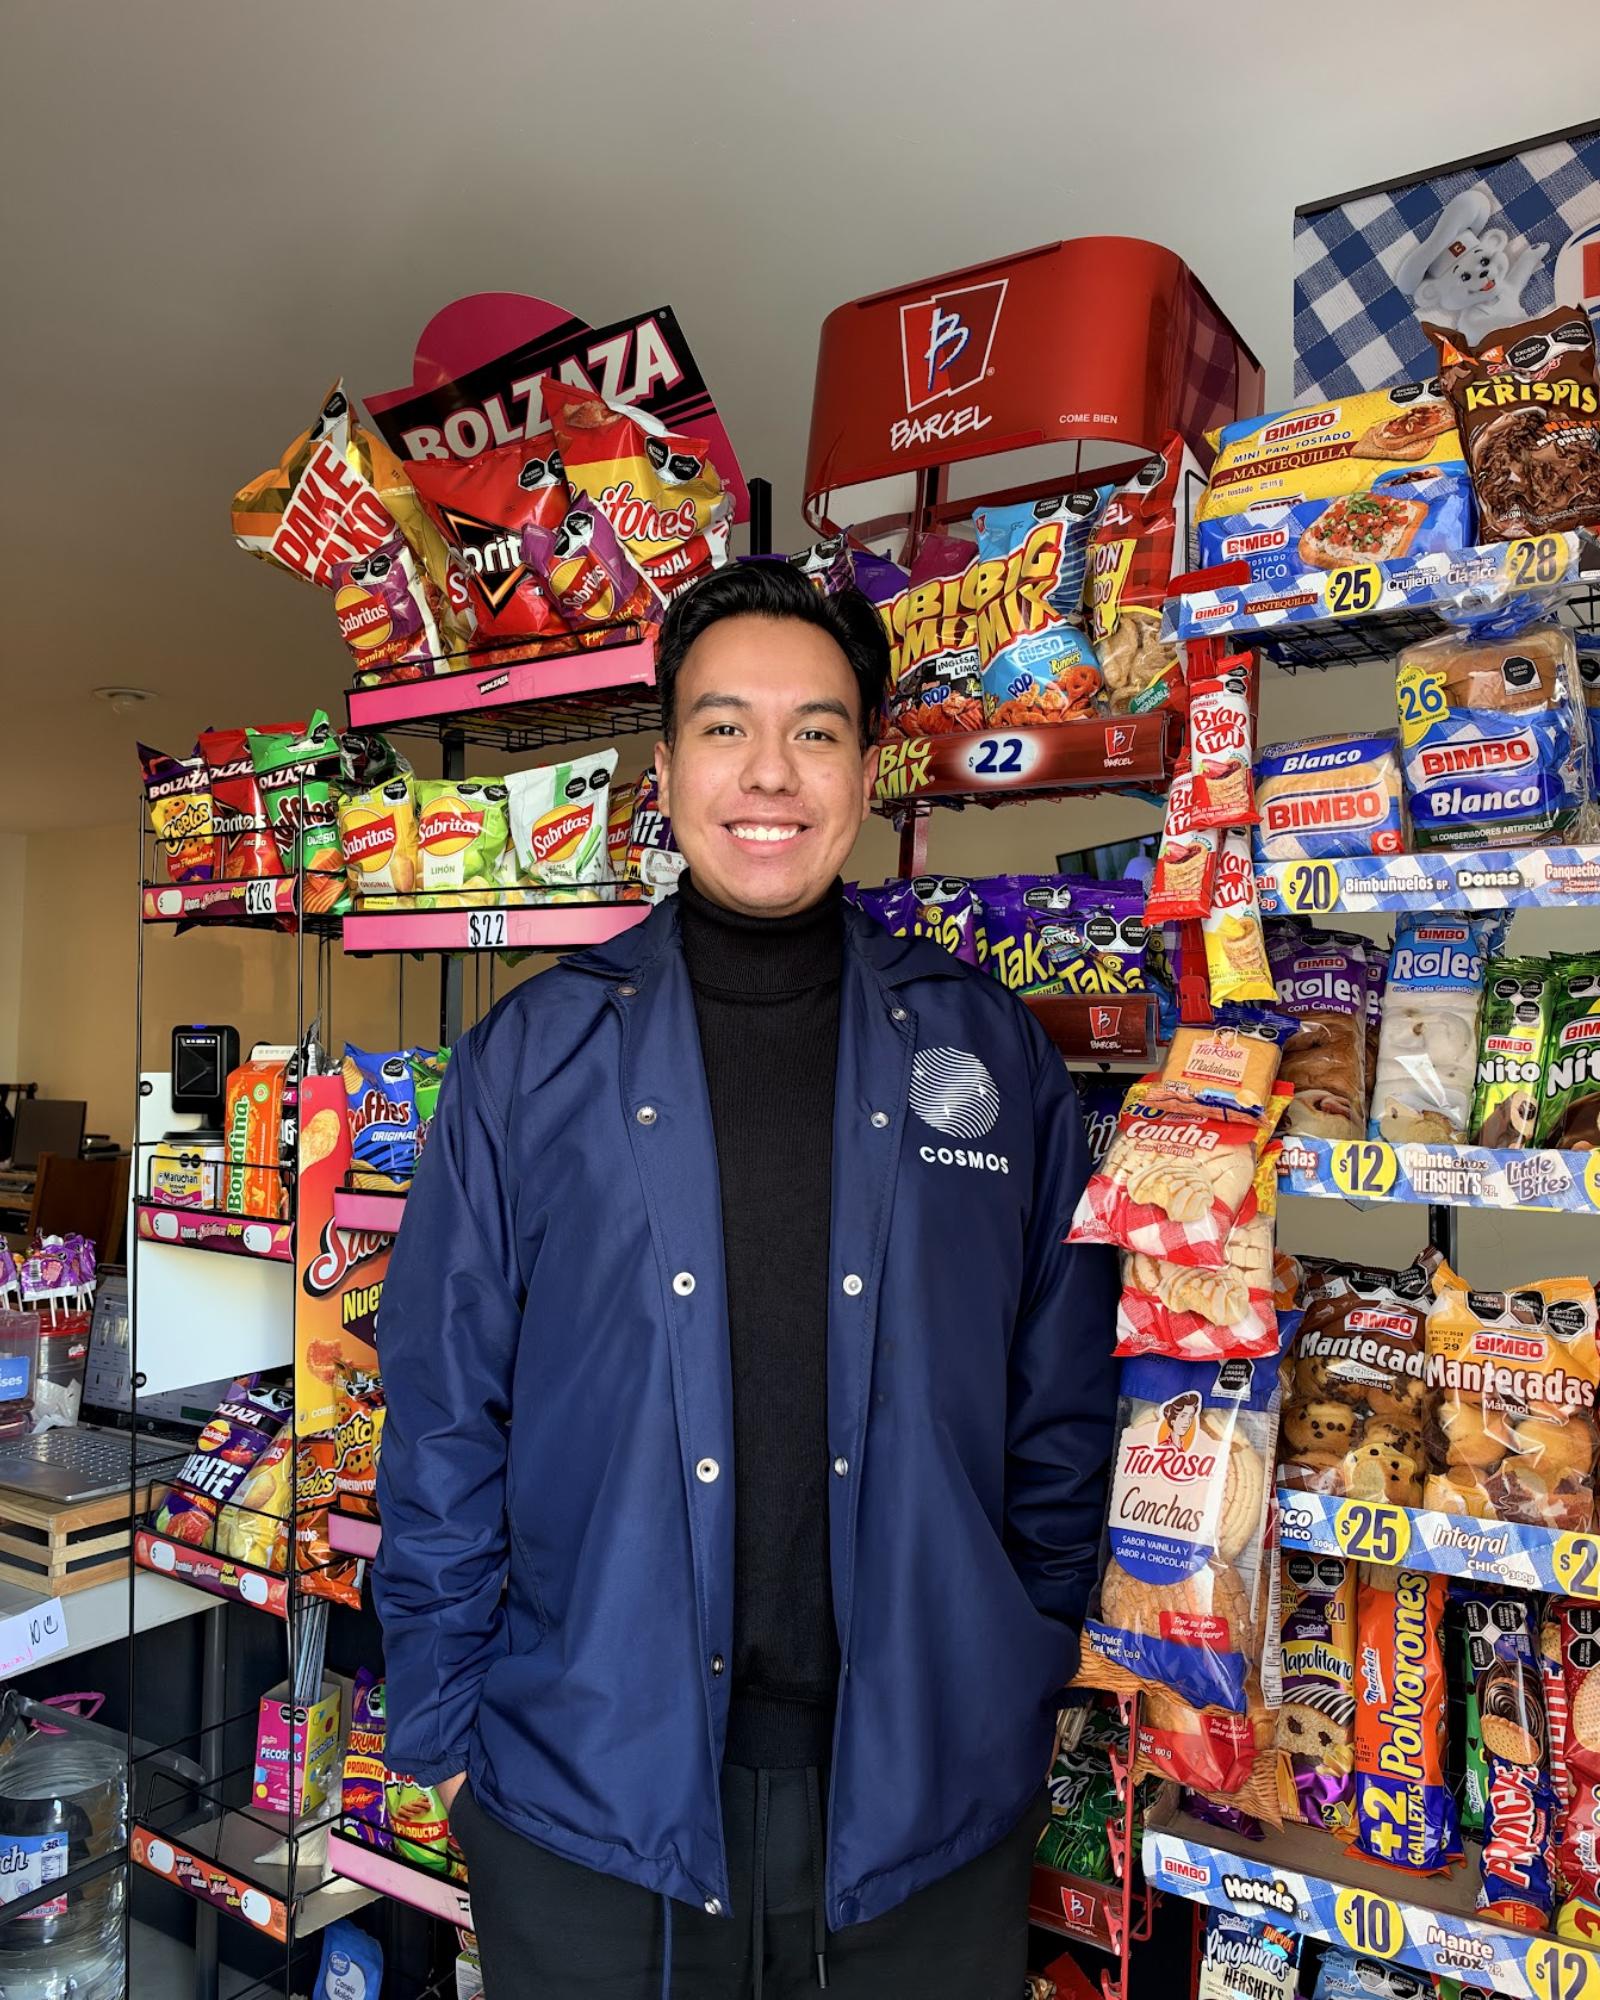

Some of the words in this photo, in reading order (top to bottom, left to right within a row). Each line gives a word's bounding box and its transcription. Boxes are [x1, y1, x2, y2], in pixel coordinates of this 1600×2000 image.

[1466, 380, 1599, 412] KRISPIS
[891, 405, 992, 450] BARCEL
[1059, 413, 1089, 424] COME
[1093, 413, 1118, 424] BIEN
[1263, 410, 1336, 443] BIMBO
[1233, 451, 1261, 464] MINI
[1266, 445, 1290, 457] PAN
[1296, 431, 1351, 451] TOSTADO
[1232, 446, 1350, 482] MANTEQUILLA
[1227, 483, 1254, 498] tostado
[1226, 530, 1286, 555] BIMBO
[977, 524, 1060, 613] BIG
[1251, 554, 1287, 568] OSTADO
[1251, 563, 1288, 581] SICO
[1447, 566, 1498, 585] Clásico
[1510, 538, 1558, 586] $28
[563, 565, 607, 611] Sabritas
[1329, 568, 1372, 613] $25
[1386, 573, 1441, 592] Crujiente
[1195, 602, 1235, 621] BIMBO
[1247, 596, 1315, 613] MANTEQUILLA
[338, 602, 389, 639] Sabritas
[977, 577, 1061, 672] MIX
[1017, 638, 1061, 664] QUESO
[922, 685, 950, 708] POP
[1008, 673, 1033, 698] POP
[1194, 706, 1248, 731] Bran
[1200, 725, 1245, 753] Frut
[879, 736, 931, 777] BIG
[968, 738, 1023, 774] $22
[1282, 749, 1361, 773] Blanco
[1422, 739, 1531, 776] BIMBO
[149, 769, 209, 799] BOLZAZA
[875, 755, 933, 800] MIX
[1267, 791, 1380, 831] BIMBO
[1431, 786, 1540, 818] Blanco
[164, 802, 210, 856] Cheetos
[418, 814, 480, 843] Sabritas
[533, 812, 591, 857] Sabritas
[1377, 832, 1397, 851] G
[1503, 820, 1554, 834] ARTIFICIALES
[342, 826, 395, 859] Sabritas
[430, 864, 455, 876] LIMÓN
[1345, 874, 1434, 893] Bimbuñuelos
[1459, 871, 1519, 887] Donas
[1546, 862, 1600, 879] Panquecito
[360, 882, 391, 890] ORIGINAL
[1289, 865, 1331, 911] $20
[469, 912, 504, 948] $22
[1418, 928, 1466, 941] BIMBO
[1299, 957, 1344, 969] BIMBO
[1393, 949, 1482, 981] Roles
[1276, 971, 1361, 1006] Roles
[1287, 1003, 1308, 1014] con
[1311, 999, 1353, 1015] Canela
[1488, 1038, 1533, 1053] BIMBO
[1477, 1059, 1540, 1084] Nito
[370, 1130, 416, 1142] ORIGINAL
[1126, 1120, 1220, 1150] Concha
[227, 1100, 248, 1212] Bonafina
[919, 1145, 1010, 1175] COSMOS
[1339, 1144, 1384, 1193] $12
[1505, 1154, 1554, 1185] Little
[163, 1172, 198, 1185] Maruchan
[1413, 1168, 1482, 1196] HERSHEY'S
[1519, 1170, 1571, 1200] Bites
[1349, 1310, 1413, 1333] BIMBO
[1474, 1334, 1544, 1358] BIMBO
[1348, 1375, 1393, 1391] Chocolate
[1427, 1353, 1595, 1408] Mantecadas
[1485, 1399, 1529, 1415] Mármol
[1120, 1486, 1205, 1533] Conchas
[1121, 1534, 1147, 1548] SABOR
[1147, 1539, 1182, 1554] VAINILLA
[1182, 1547, 1189, 1556] Y
[1341, 1506, 1398, 1561] $25
[1433, 1524, 1508, 1557] Integral
[1115, 1546, 1141, 1559] SABOR
[1140, 1552, 1147, 1561] A
[1147, 1554, 1196, 1571] CHOCOLATE
[1467, 1558, 1508, 1577] CHICO
[1171, 1626, 1193, 1638] sabor
[1174, 1616, 1188, 1628] Por
[1089, 1630, 1100, 1641] Pan
[1101, 1632, 1122, 1646] Dulce
[1364, 1644, 1386, 1704] Marinela
[1378, 1572, 1429, 1779] Polvorones
[1321, 1804, 1335, 1822] 2
[1363, 1787, 1406, 1858] +2
[1407, 1785, 1424, 1866] GALLETAS
[1164, 1860, 1208, 1884] BIMBO
[1226, 1874, 1297, 1915] Hotkis
[1343, 1894, 1392, 1953] $10
[1207, 1928, 1290, 1982] Pingüinos
[1426, 1925, 1496, 1961] Mante
[1436, 1950, 1484, 1971] chox
[1535, 1947, 1588, 2000] $12
[1223, 1967, 1285, 2000] HERSHEY'S
